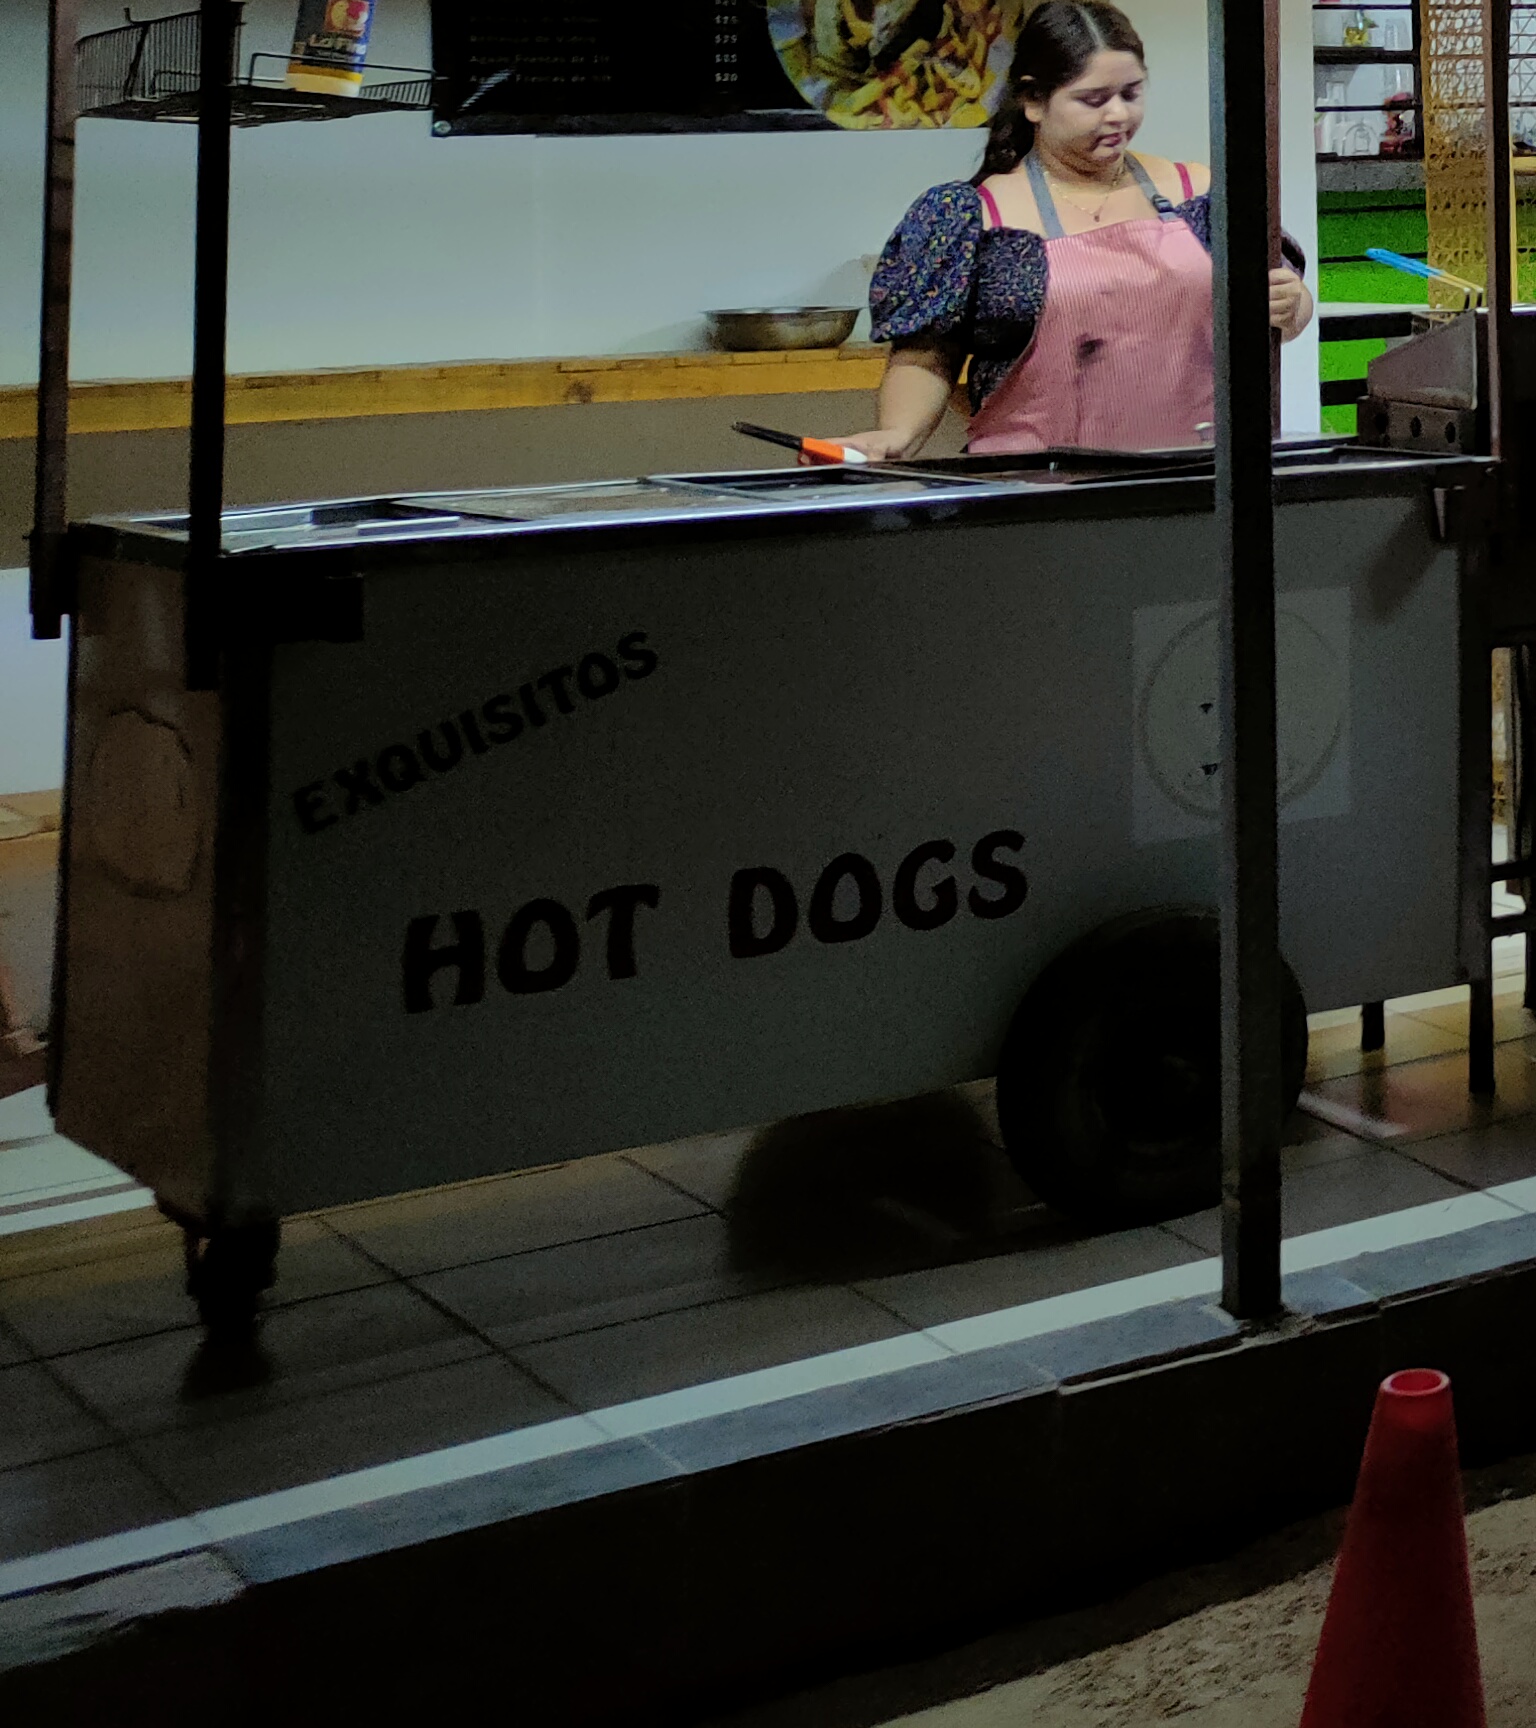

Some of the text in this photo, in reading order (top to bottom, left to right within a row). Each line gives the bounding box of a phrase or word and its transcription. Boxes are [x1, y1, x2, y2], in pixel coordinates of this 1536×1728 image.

[293, 632, 658, 834] EXQUISITOS
[403, 830, 1028, 1014] HOT DOGS
